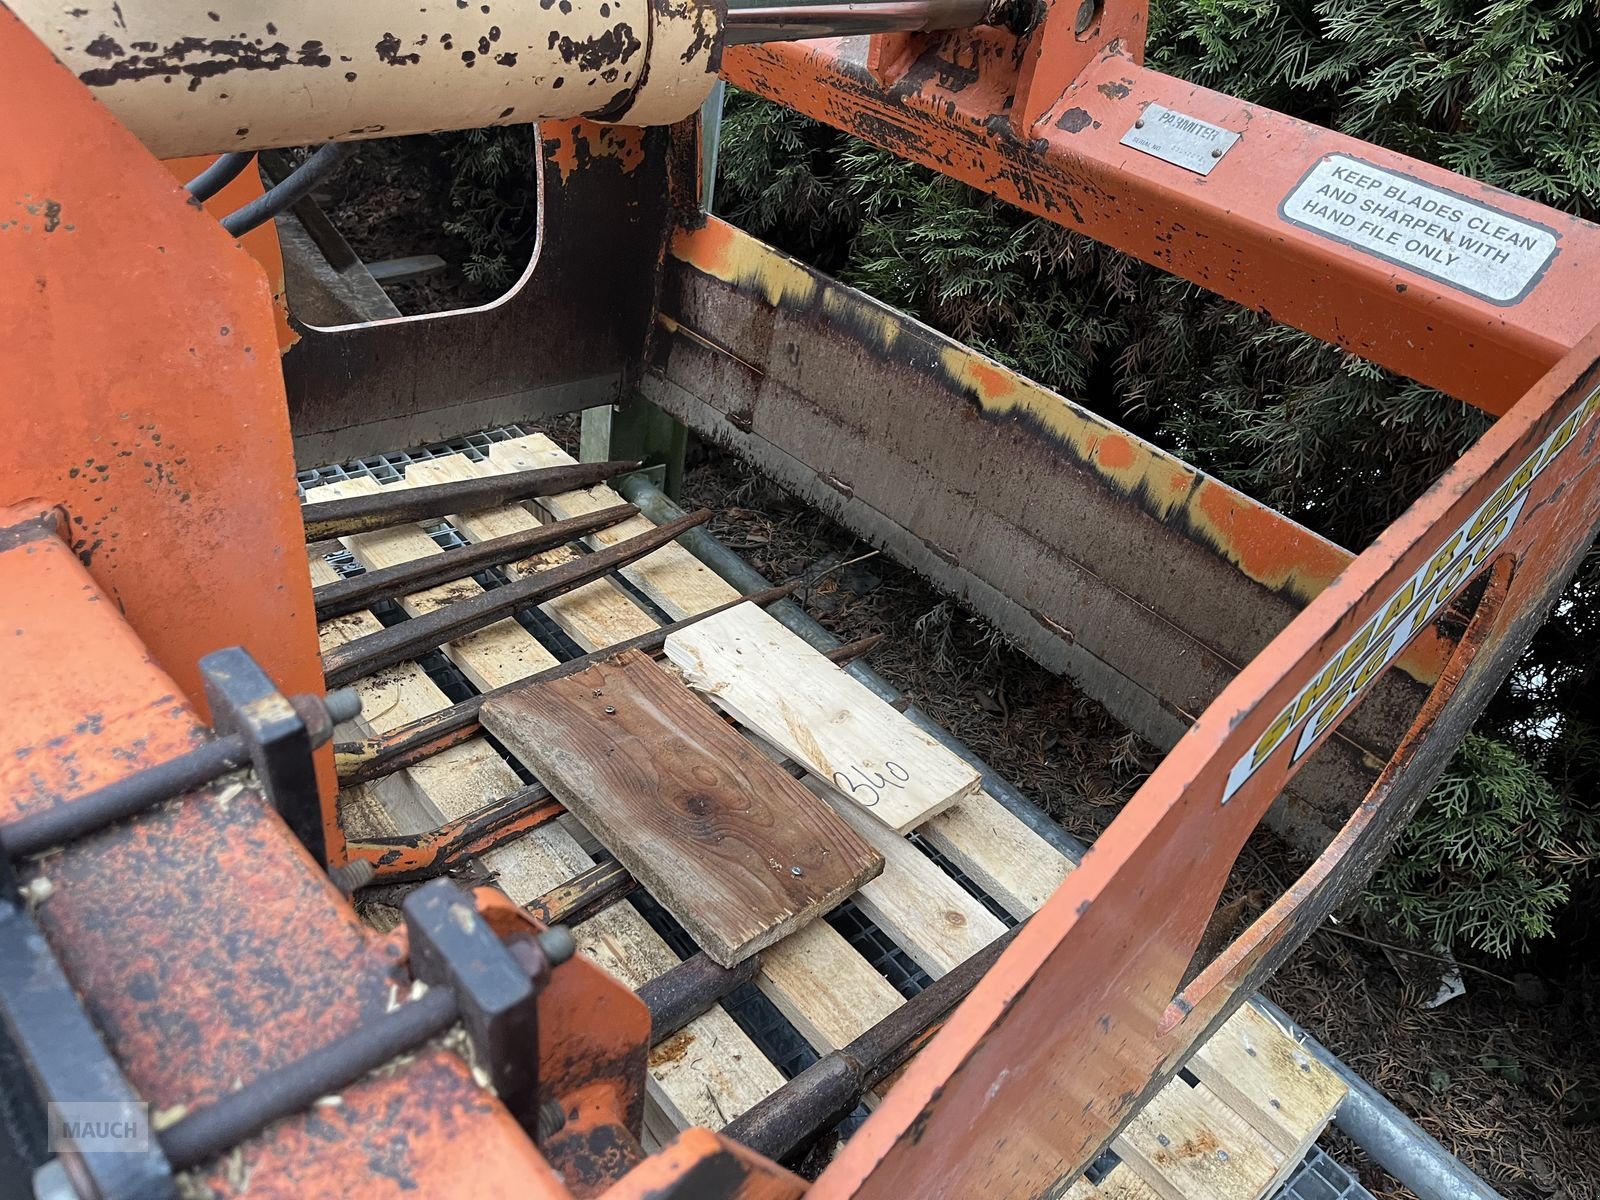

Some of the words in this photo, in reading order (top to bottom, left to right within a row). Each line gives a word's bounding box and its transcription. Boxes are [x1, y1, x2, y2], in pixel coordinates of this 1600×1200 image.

[1159, 112, 1219, 141] PARMITER
[1302, 200, 1355, 226] HAND
[1358, 222, 1402, 245] FILE
[1405, 239, 1459, 266] ONLY
[1316, 184, 1358, 205] AND
[1360, 199, 1454, 243] SHARPEN
[1459, 235, 1511, 264] WITH
[1331, 166, 1382, 190] KEEP
[1386, 187, 1464, 222] BLADES
[1467, 217, 1538, 250] CLEAN
[1313, 639, 1393, 736] SG
[1410, 515, 1509, 635] 100
